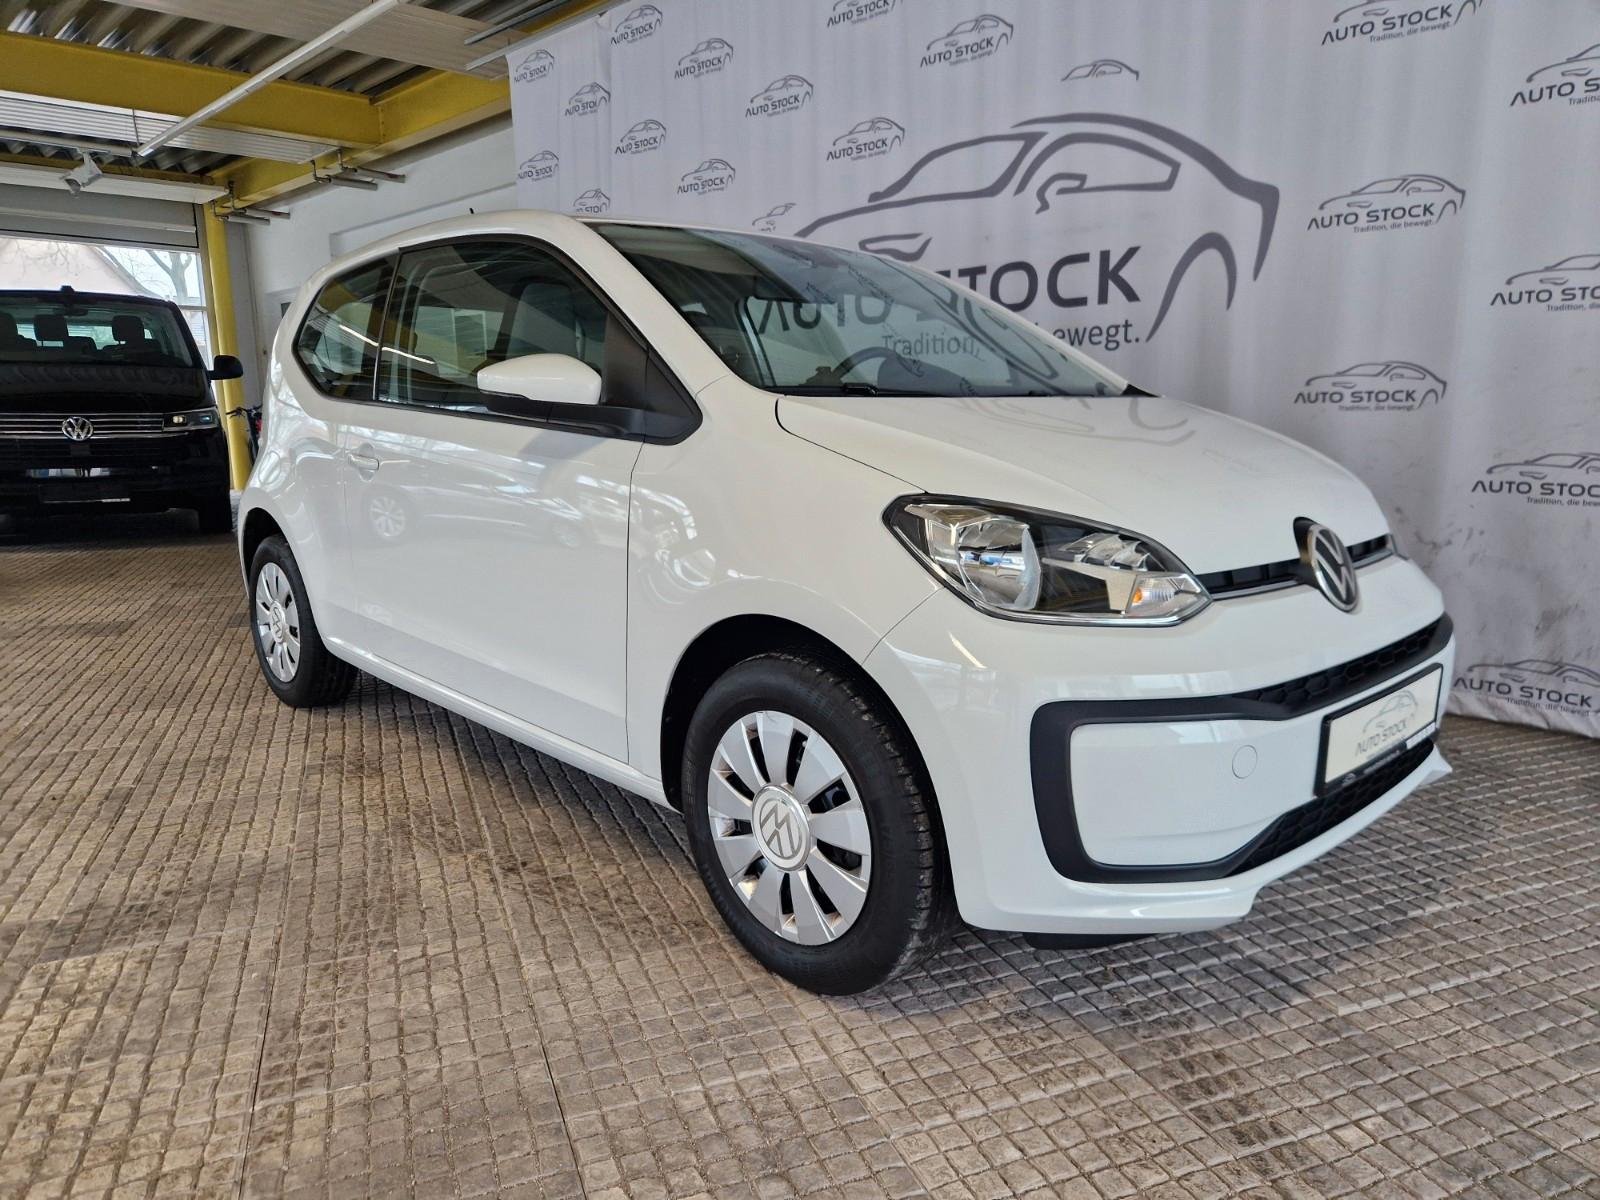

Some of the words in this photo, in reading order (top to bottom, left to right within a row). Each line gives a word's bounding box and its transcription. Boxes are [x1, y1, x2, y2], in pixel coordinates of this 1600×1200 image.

[827, 10, 853, 27] AUTO
[856, 0, 890, 16] STOCK
[1321, 21, 1375, 46] AUTO
[1382, 4, 1453, 31] STOCK
[610, 32, 629, 46] AUTO
[630, 22, 653, 39] STOCK
[920, 50, 952, 68] AUTO
[955, 36, 994, 57] STOCK
[674, 66, 696, 80] AUTO
[697, 55, 723, 73] STOCK
[1510, 81, 1575, 106] AUTO
[745, 104, 769, 118] AUTO
[771, 94, 800, 111] STOCK
[634, 136, 659, 149] STOCK
[826, 146, 854, 161] AUTO
[855, 138, 888, 154] STOCK
[677, 183, 700, 195] AUTO
[701, 176, 725, 190] STOCK
[1307, 212, 1359, 231] AUTO
[1366, 203, 1435, 223] STOCK
[1490, 289, 1553, 306] AUTO
[1294, 391, 1344, 404] AUTO
[1350, 390, 1417, 403] STOCK
[1471, 480, 1532, 495] AUTO
[1454, 677, 1512, 695] AUTO
[1520, 685, 1593, 708] STOCK
